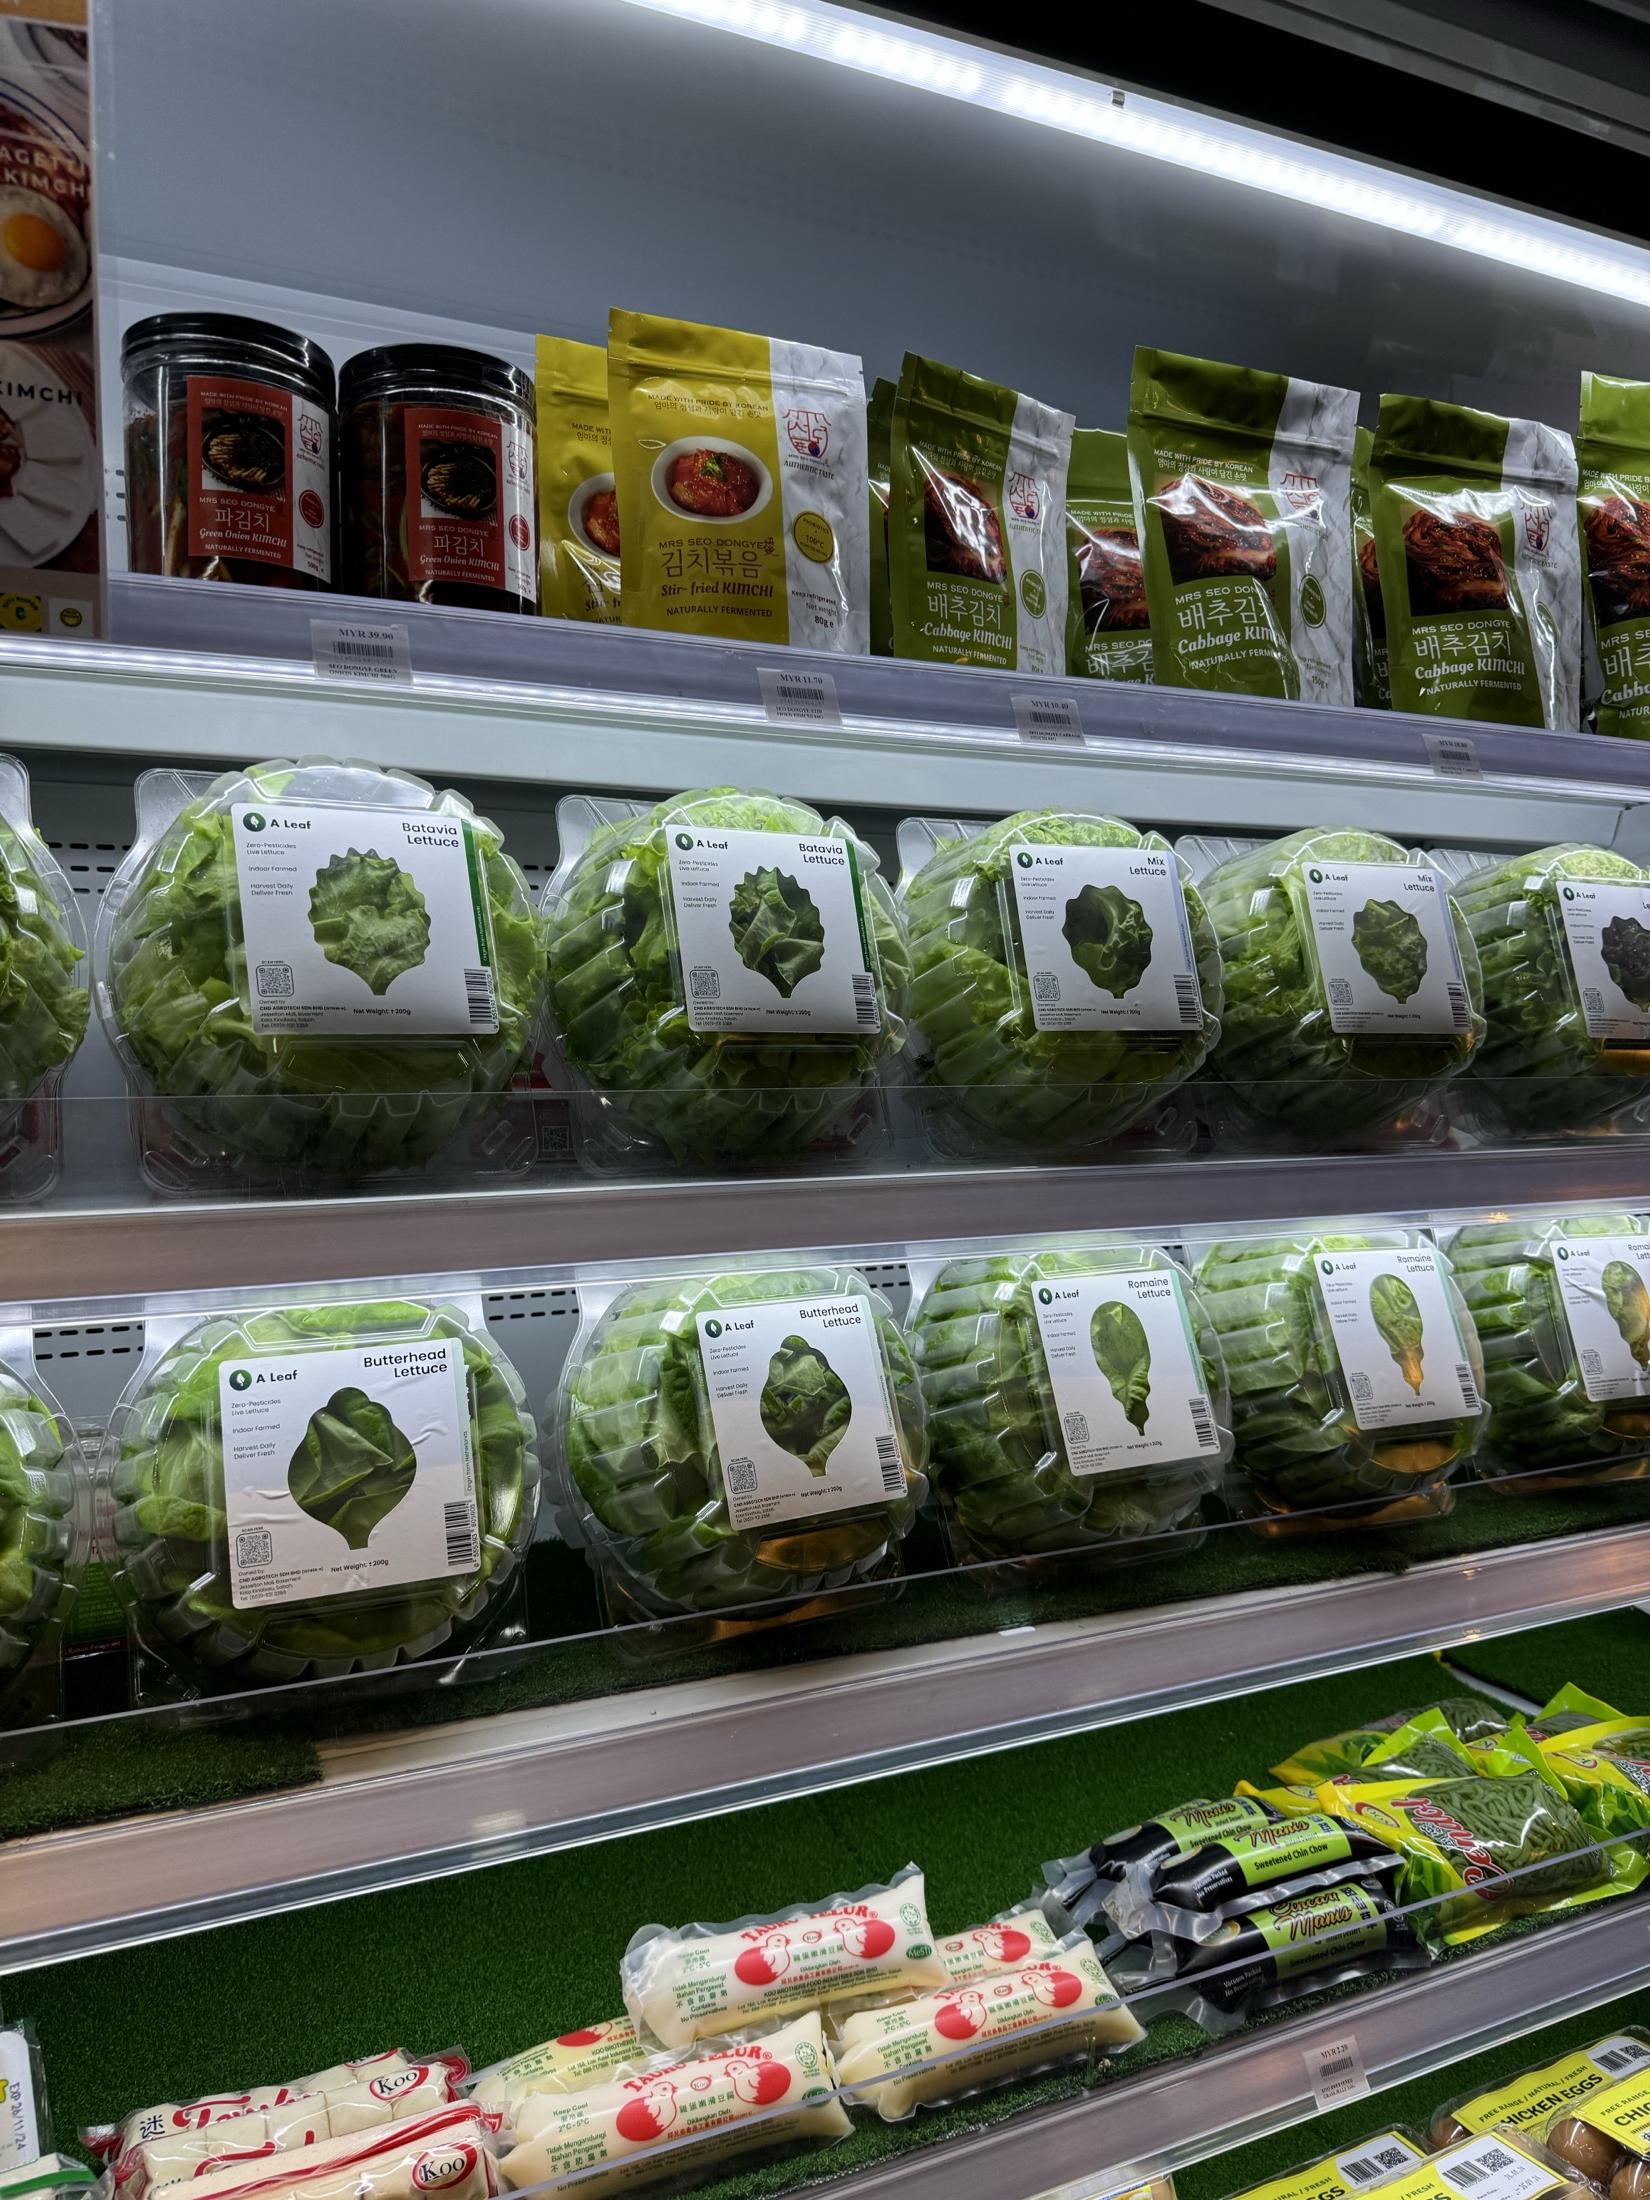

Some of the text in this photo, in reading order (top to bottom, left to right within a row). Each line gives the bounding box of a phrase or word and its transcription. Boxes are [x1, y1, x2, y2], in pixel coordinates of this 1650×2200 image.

[674, 396, 694, 404] WITH
[695, 399, 721, 407] PRIDE
[735, 403, 769, 412] KOREAN
[1153, 449, 1254, 473] MADE WITH PRIDE BY KOREAN
[1619, 474, 1642, 483] PRIDE
[199, 496, 276, 512] MRS SEO DONGYE
[215, 508, 270, 534] 파김치
[200, 527, 288, 548] Green Onion KIMCHI
[419, 524, 489, 538] MRS SEO DONGYE
[204, 543, 282, 560] NATURALLY FERMENTED
[434, 535, 485, 558] 파김치
[658, 538, 763, 550] MRS SEO DONGYE
[419, 554, 501, 571] Green Onion KIMCHI
[660, 548, 763, 579] 김치볶음
[660, 582, 774, 598] Stir- fried KIMCHI
[926, 580, 1004, 602] MRS SEO DONGYE
[1175, 587, 1230, 606] MRS SEO
[666, 605, 773, 618] NATURALLY FERMENTED
[928, 595, 1001, 630] 배추김치
[814, 615, 829, 628] 80g
[1411, 619, 1511, 636] MRS SEO DONGYE
[338, 628, 394, 641] MYR 39.90
[923, 622, 1013, 650] Cabbage KIMCHI
[1600, 633, 1629, 650] MRS
[1111, 641, 1134, 651] SEO
[1177, 631, 1241, 655] Cabbage
[1413, 631, 1511, 660] 배추김치
[932, 644, 1007, 665] NATURALLY FERMENTED
[1189, 649, 1247, 670] NATURALLY
[1414, 658, 1526, 680] Cabbage KIMCHI
[1426, 679, 1523, 696] NATURALLY FERMENTED
[270, 819, 312, 830] A Leaf
[402, 822, 457, 836] Batavia
[406, 835, 460, 848] Lettuce
[696, 839, 729, 850] A Leaf
[799, 843, 843, 854] Batavia
[803, 855, 845, 866] Lettuce
[1035, 857, 1063, 866] A Leaf
[1147, 857, 1165, 866] Mix
[1129, 866, 1167, 876] Lettuce
[1325, 873, 1331, 881] A
[1418, 874, 1433, 882] Mix
[276, 882, 294, 890] Daily
[1403, 883, 1435, 892] Lettuce
[1397, 1255, 1432, 1264] Romaine
[1406, 1264, 1435, 1274] Lettuce
[1128, 1277, 1169, 1289] Romaine
[1055, 1289, 1080, 1300] A Leaf
[1137, 1288, 1171, 1300] Lettuce
[799, 1303, 859, 1319] Butterhead
[725, 1319, 755, 1332] A Leaf
[823, 1315, 862, 1329] Lettuce
[363, 1348, 447, 1368] Butterhead
[256, 1369, 298, 1384] A Leaf
[394, 1363, 448, 1378] Lettuce
[231, 1398, 281, 1409] Zero-Pesticides
[232, 1423, 281, 1434] Indoor Farmed
[233, 1441, 276, 1453] Harvest Daily
[234, 1450, 275, 1460] Deliver Fresh
[1189, 1831, 1222, 1848] Sweetened
[1223, 1827, 1235, 1838] Chin
[1254, 1842, 1329, 1871] Sweetened Chin Chow
[1274, 1904, 1353, 1942] Manis
[376, 2070, 417, 2096] Koo
[1560, 2073, 1604, 2100] EGGS
[1479, 2107, 1499, 2123] FREE
[1499, 2098, 1525, 2112] RANGE
[1528, 2080, 1561, 2097] NATURAL
[1564, 2064, 1588, 2080] FRESH
[553, 2102, 588, 2117] Keep Cool
[1600, 2088, 1645, 2116] FREE RANGE
[140, 2114, 165, 2139] 迷
[546, 2130, 607, 2155] Tidak Mengandungi
[551, 2140, 604, 2163] Bahan Pengawet
[420, 2156, 466, 2183] Koo
[1304, 2176, 1333, 2192] FRESH
[1407, 2182, 1435, 2199] FRESH
